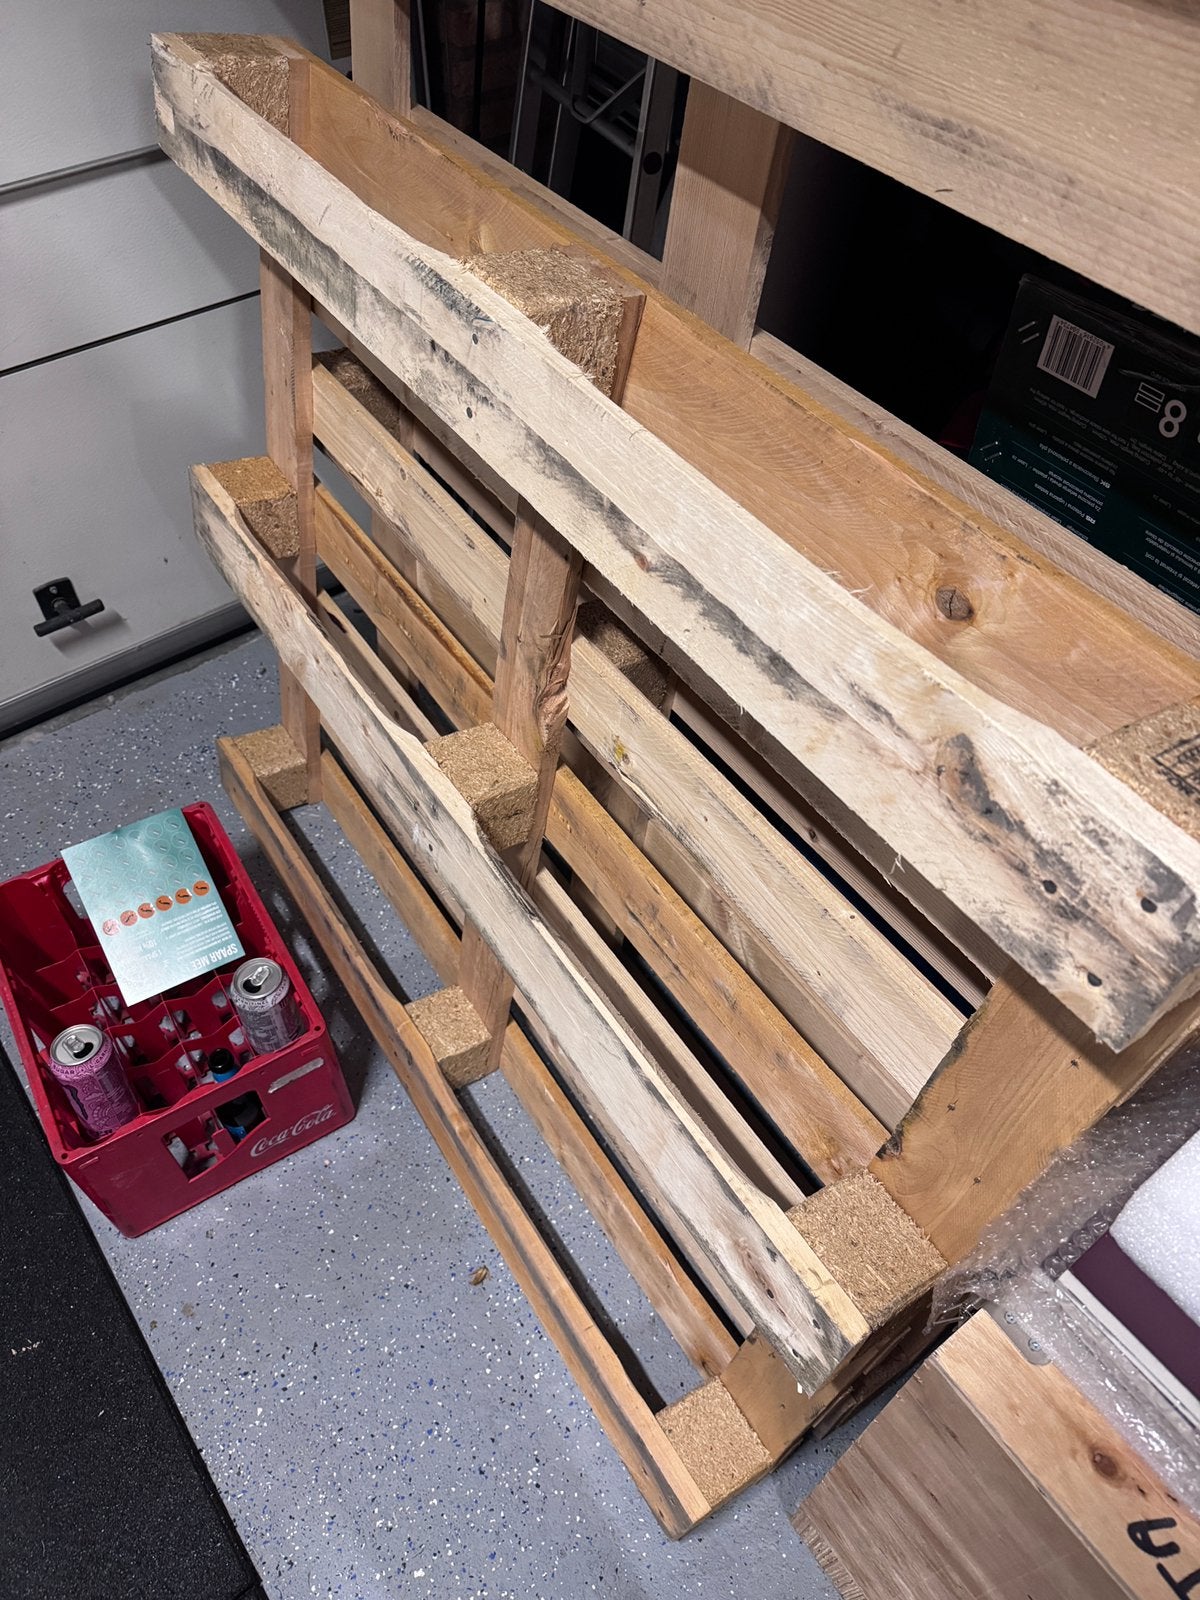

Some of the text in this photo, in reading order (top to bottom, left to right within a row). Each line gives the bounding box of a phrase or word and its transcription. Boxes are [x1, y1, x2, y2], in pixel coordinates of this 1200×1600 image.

[1158, 399, 1187, 438] 8
[208, 942, 238, 963] SPAAR
[250, 1104, 336, 1158] Coca-Cola
